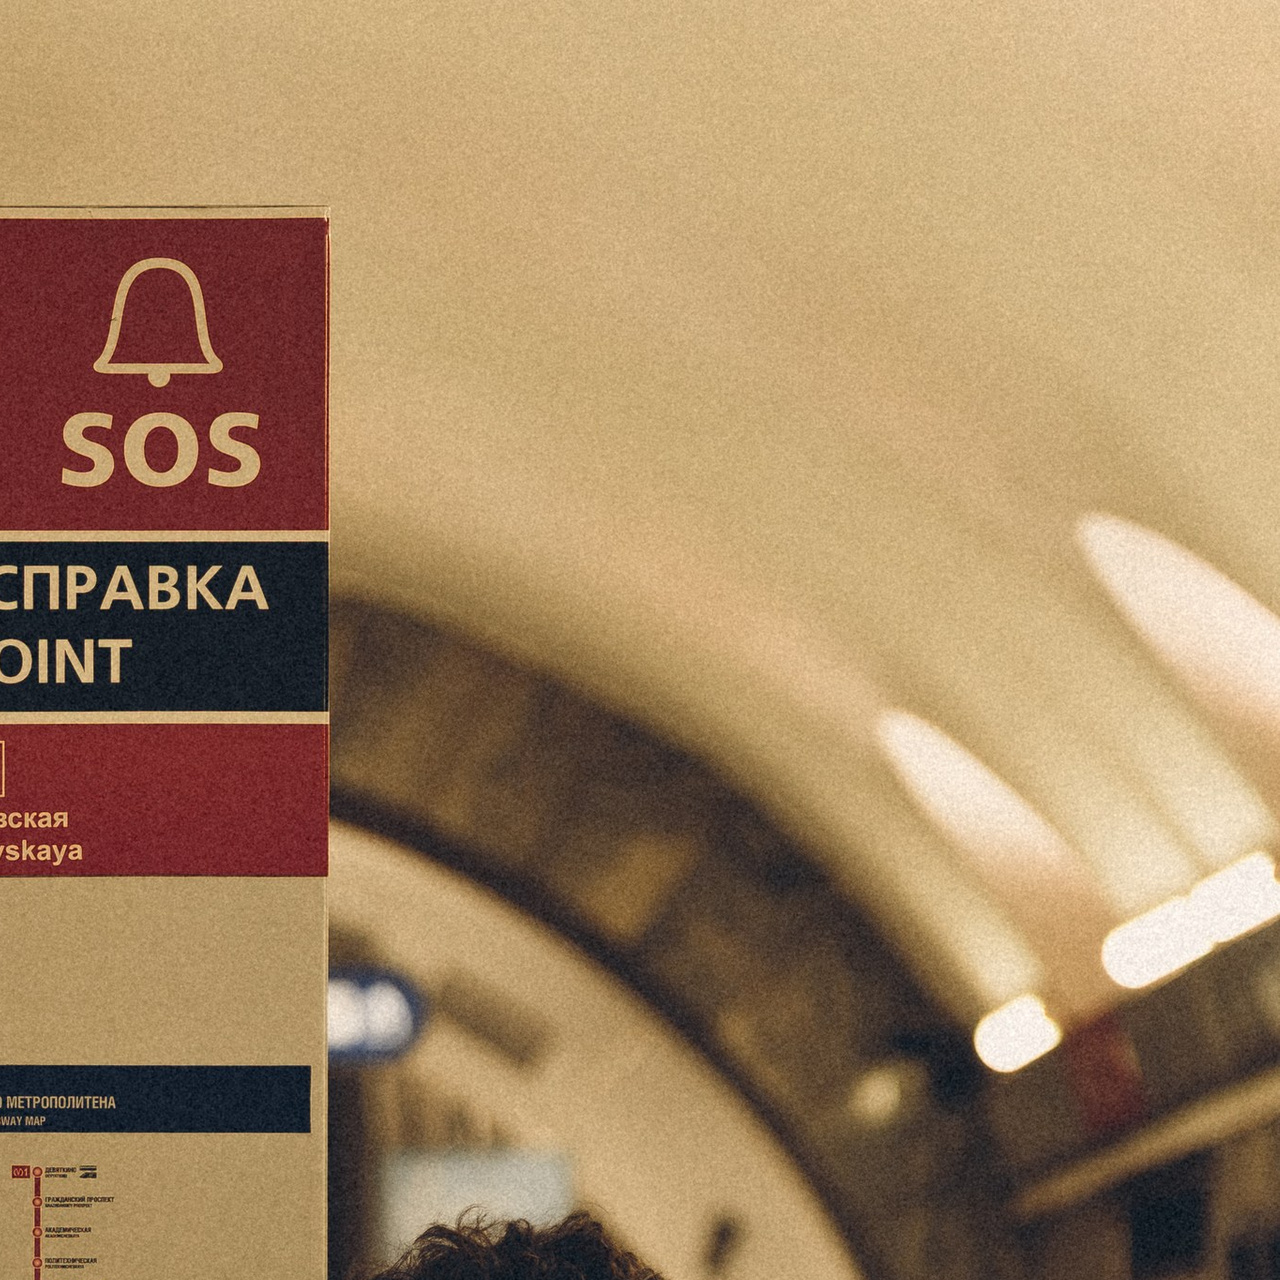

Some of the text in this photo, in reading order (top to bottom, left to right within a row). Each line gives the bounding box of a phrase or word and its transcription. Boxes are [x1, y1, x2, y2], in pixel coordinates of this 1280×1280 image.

[61, 411, 261, 488] SOS
[7, 1096, 116, 1110] МЕТРОПОЛИТЕНА
[24, 1116, 46, 1126] MAP
